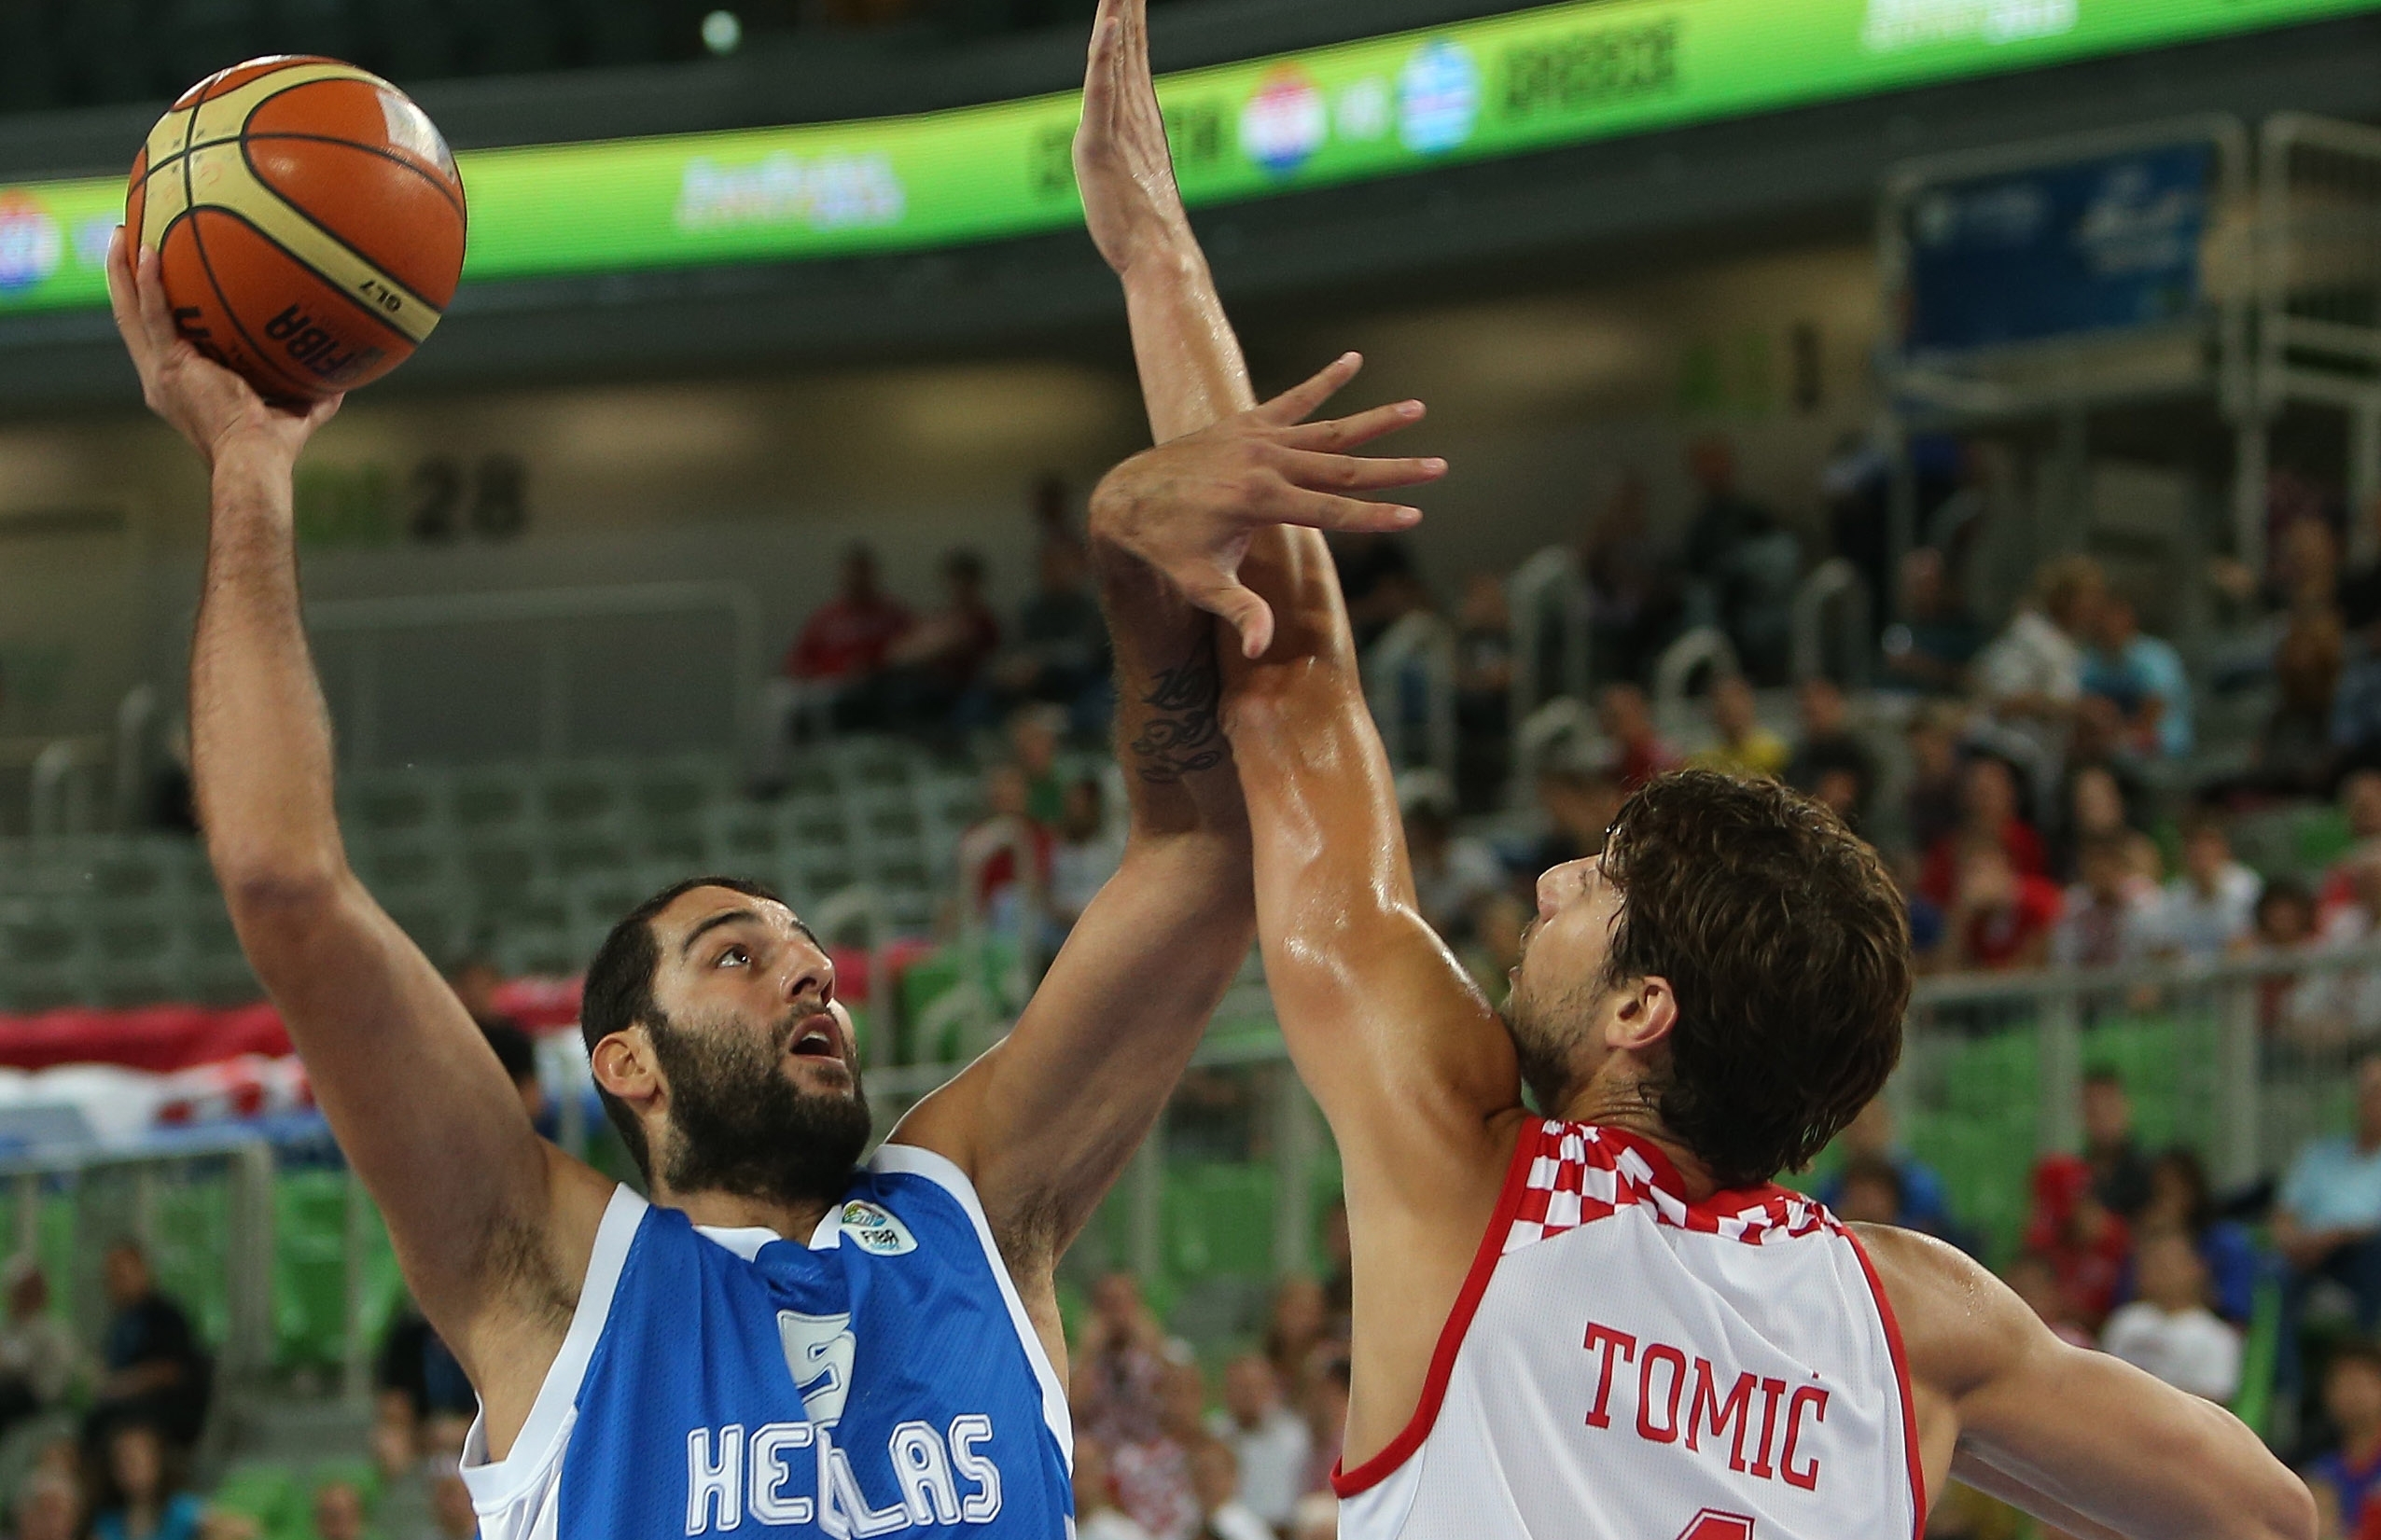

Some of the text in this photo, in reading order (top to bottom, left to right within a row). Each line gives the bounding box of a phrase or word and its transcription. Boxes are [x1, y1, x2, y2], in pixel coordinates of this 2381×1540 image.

[359, 281, 402, 312] GL7
[264, 302, 356, 375] FIBA
[411, 454, 529, 543] 28
[860, 1229, 899, 1244] FIBA
